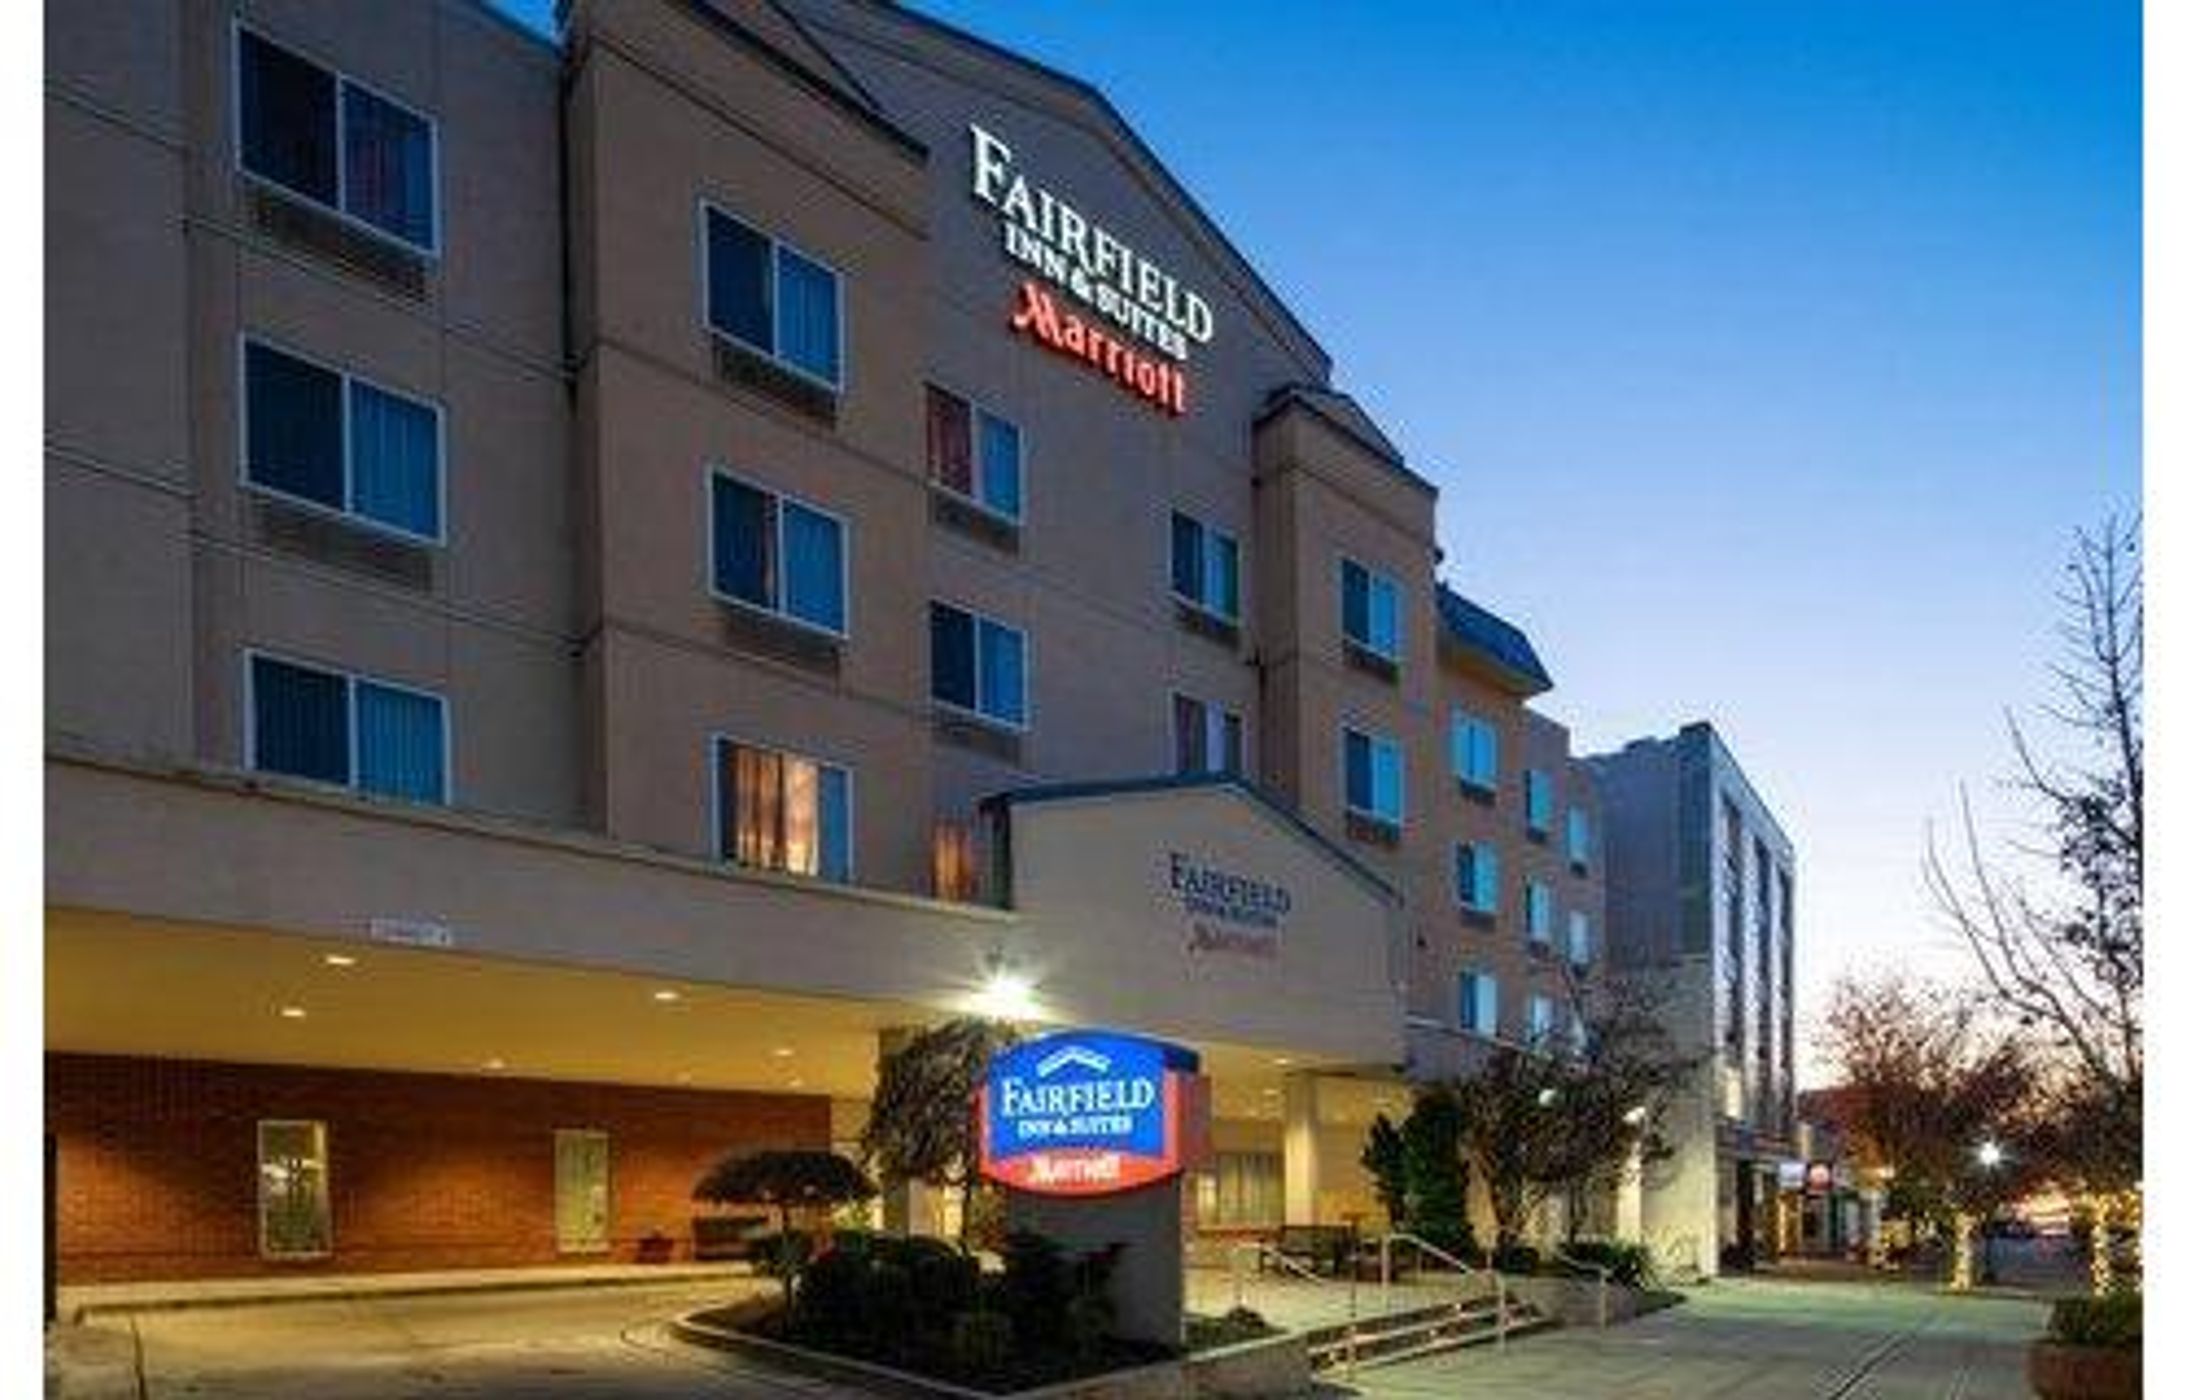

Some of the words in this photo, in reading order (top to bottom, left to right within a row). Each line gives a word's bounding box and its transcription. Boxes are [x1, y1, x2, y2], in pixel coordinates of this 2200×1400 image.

[969, 123, 1213, 343] FAIRFIELD
[1005, 223, 1066, 285] INN
[1070, 267, 1094, 302] &
[1097, 284, 1187, 360] SUITES
[1013, 283, 1186, 413] Marriott
[1002, 1077, 1155, 1116] FAIRFIELD
